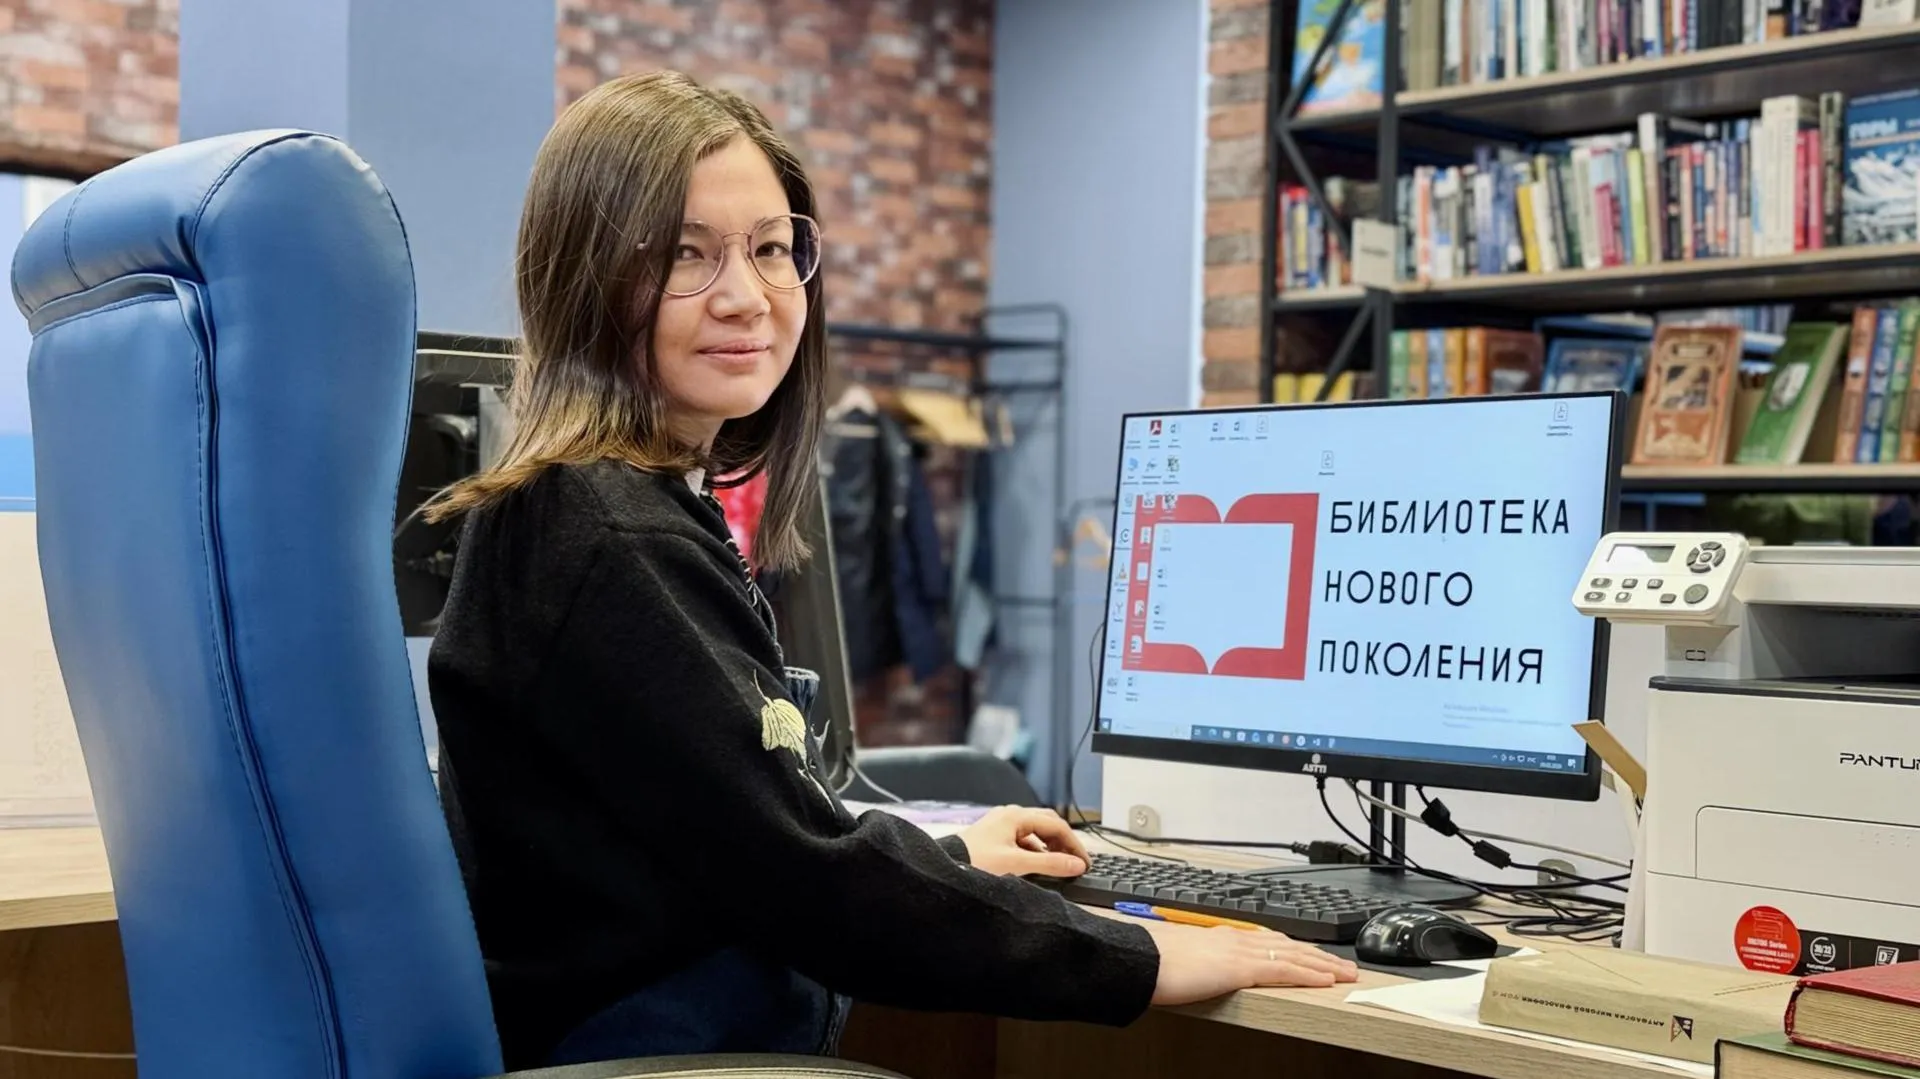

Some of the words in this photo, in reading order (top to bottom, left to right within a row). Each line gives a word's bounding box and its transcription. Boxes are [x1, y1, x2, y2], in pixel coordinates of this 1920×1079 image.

[1330, 499, 1569, 534] БИБЛИОТЕКА
[1324, 569, 1473, 607] НОВОГО
[1318, 640, 1544, 684] ПОКОЛЕНИЯ
[1839, 752, 1920, 771] PANTU
